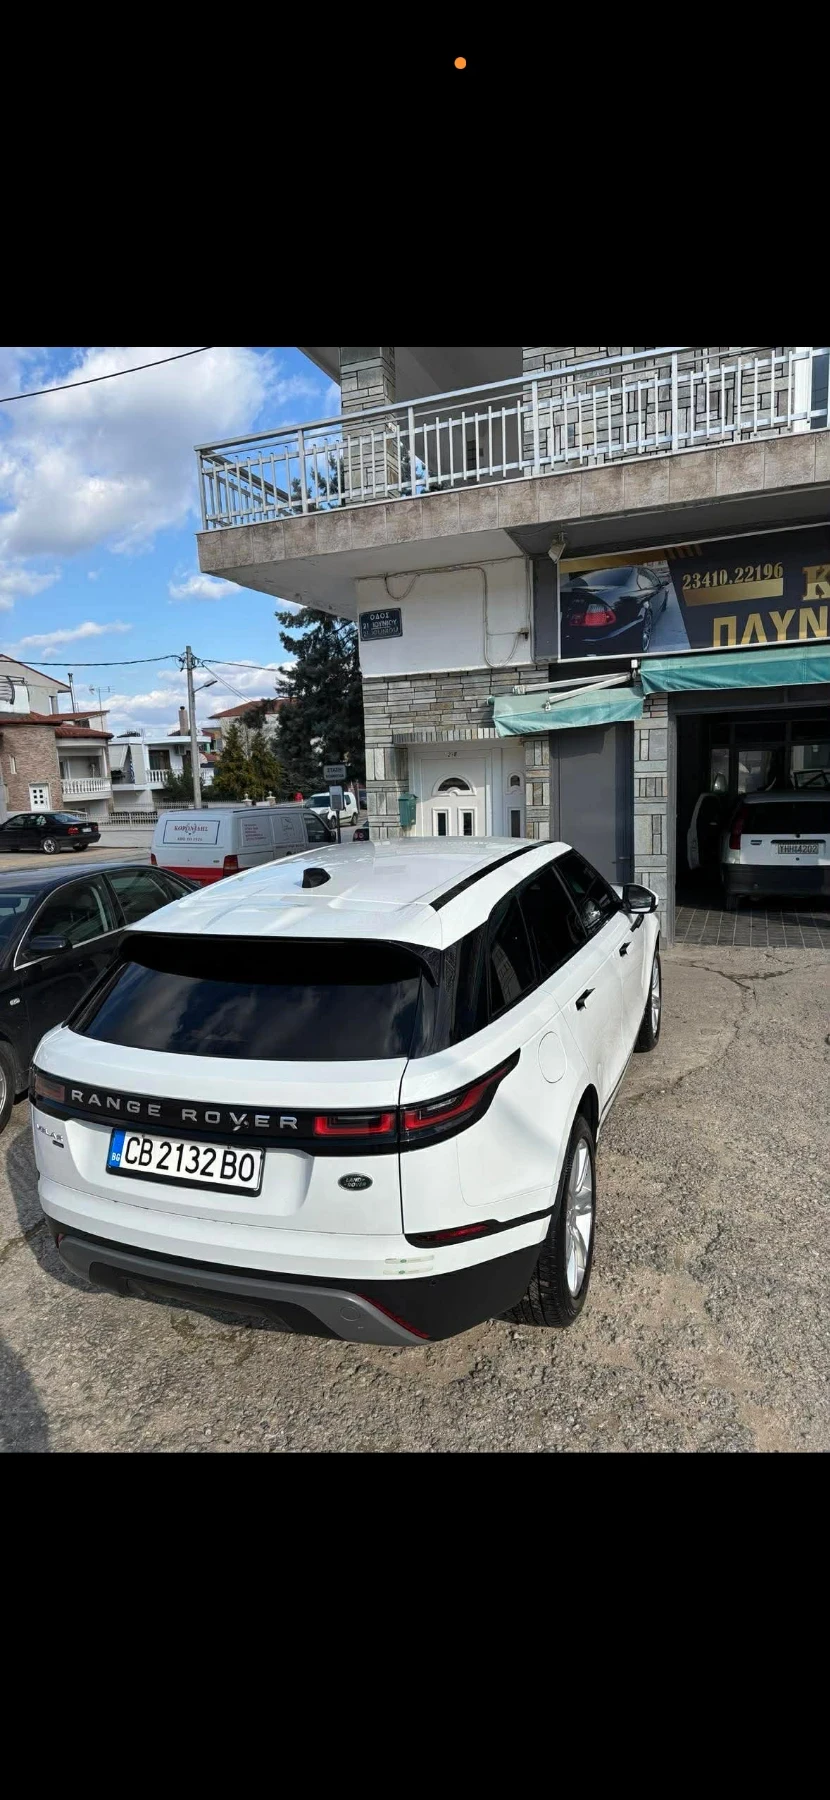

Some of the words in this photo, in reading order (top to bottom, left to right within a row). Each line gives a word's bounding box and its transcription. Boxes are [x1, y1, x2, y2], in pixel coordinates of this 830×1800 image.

[682, 562, 784, 590] 23410.22196
[370, 612, 389, 621] ΟΔΟΣ
[71, 1089, 162, 1117] RANGE
[181, 1108, 299, 1130] ROVER
[111, 1152, 121, 1161] BG
[125, 1136, 154, 1166] CB
[156, 1141, 217, 1177] 2132
[219, 1149, 255, 1182] BO
